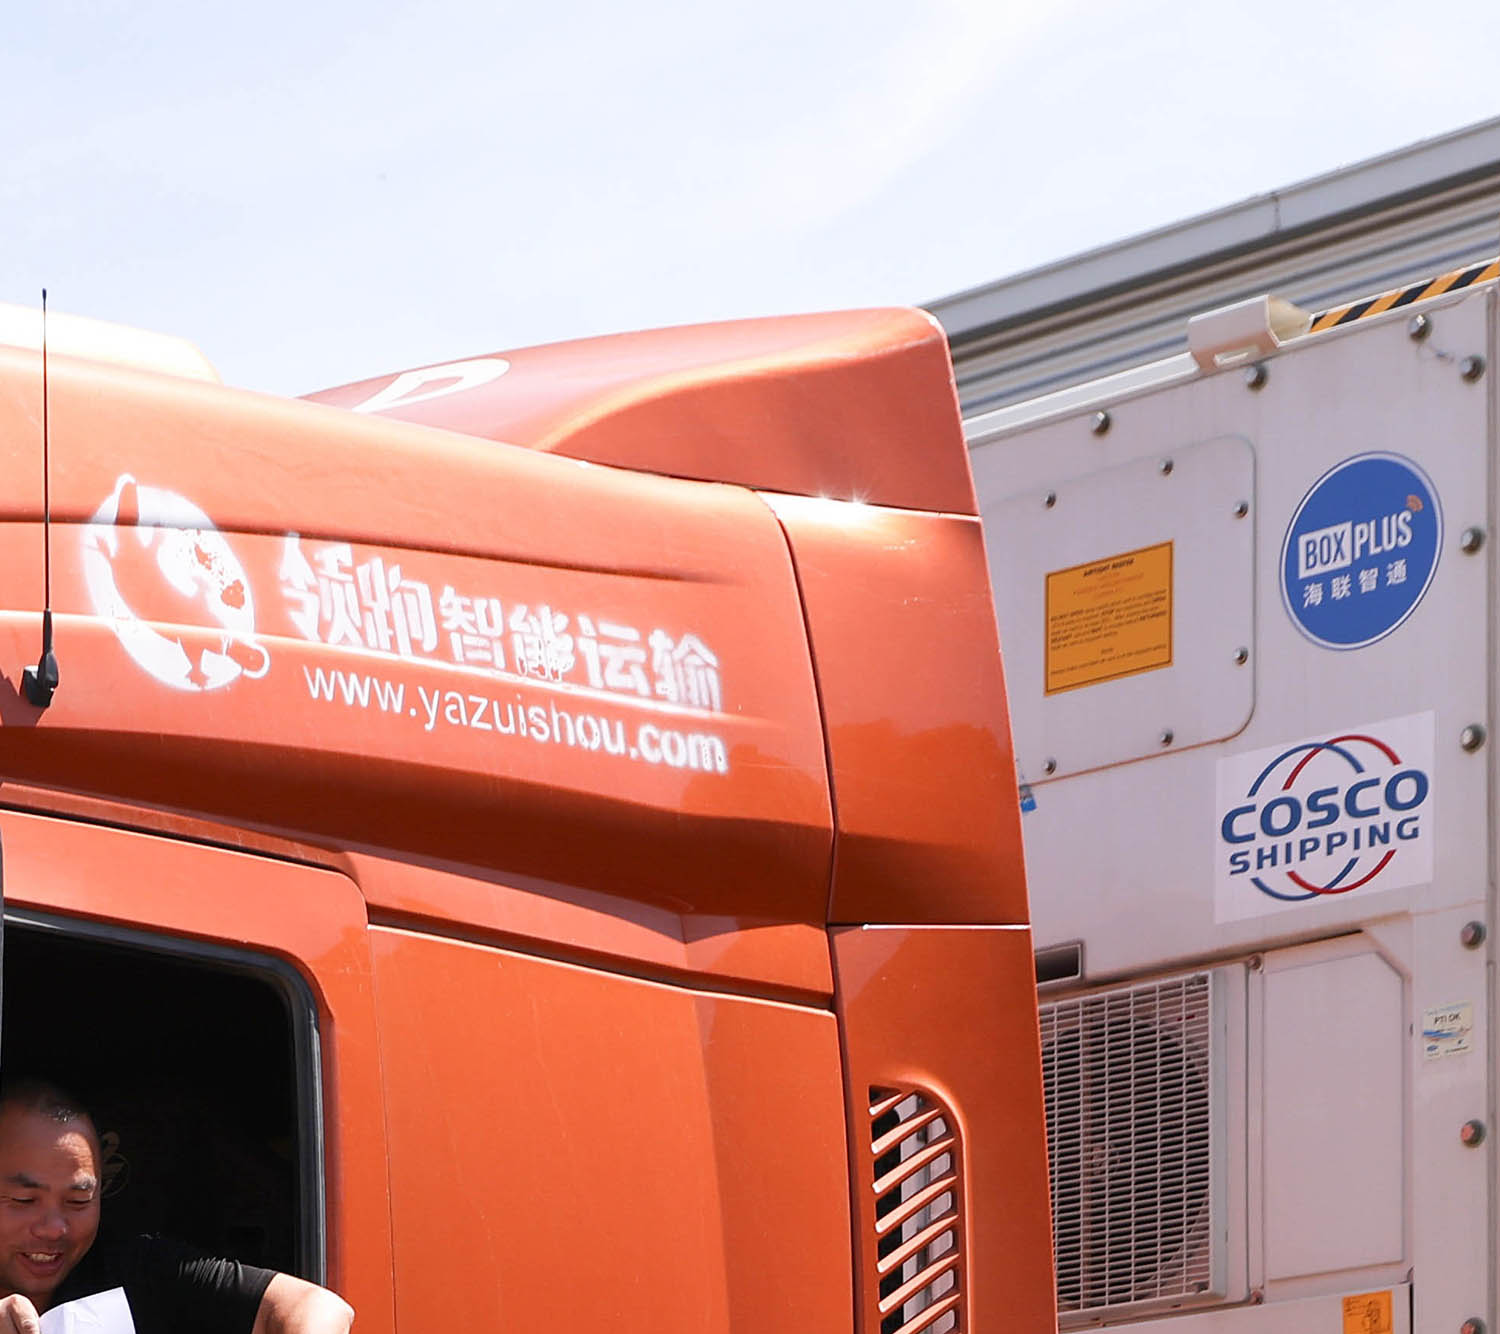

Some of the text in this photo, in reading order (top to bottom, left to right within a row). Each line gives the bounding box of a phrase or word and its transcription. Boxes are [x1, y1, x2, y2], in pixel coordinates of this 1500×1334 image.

[1304, 511, 1413, 571] BOX PLUS
[1302, 560, 1409, 609] 海联智通
[302, 664, 728, 775] www.yazuishou.com
[1220, 768, 1430, 845] COSCO
[1228, 815, 1421, 876] SHIPPING
